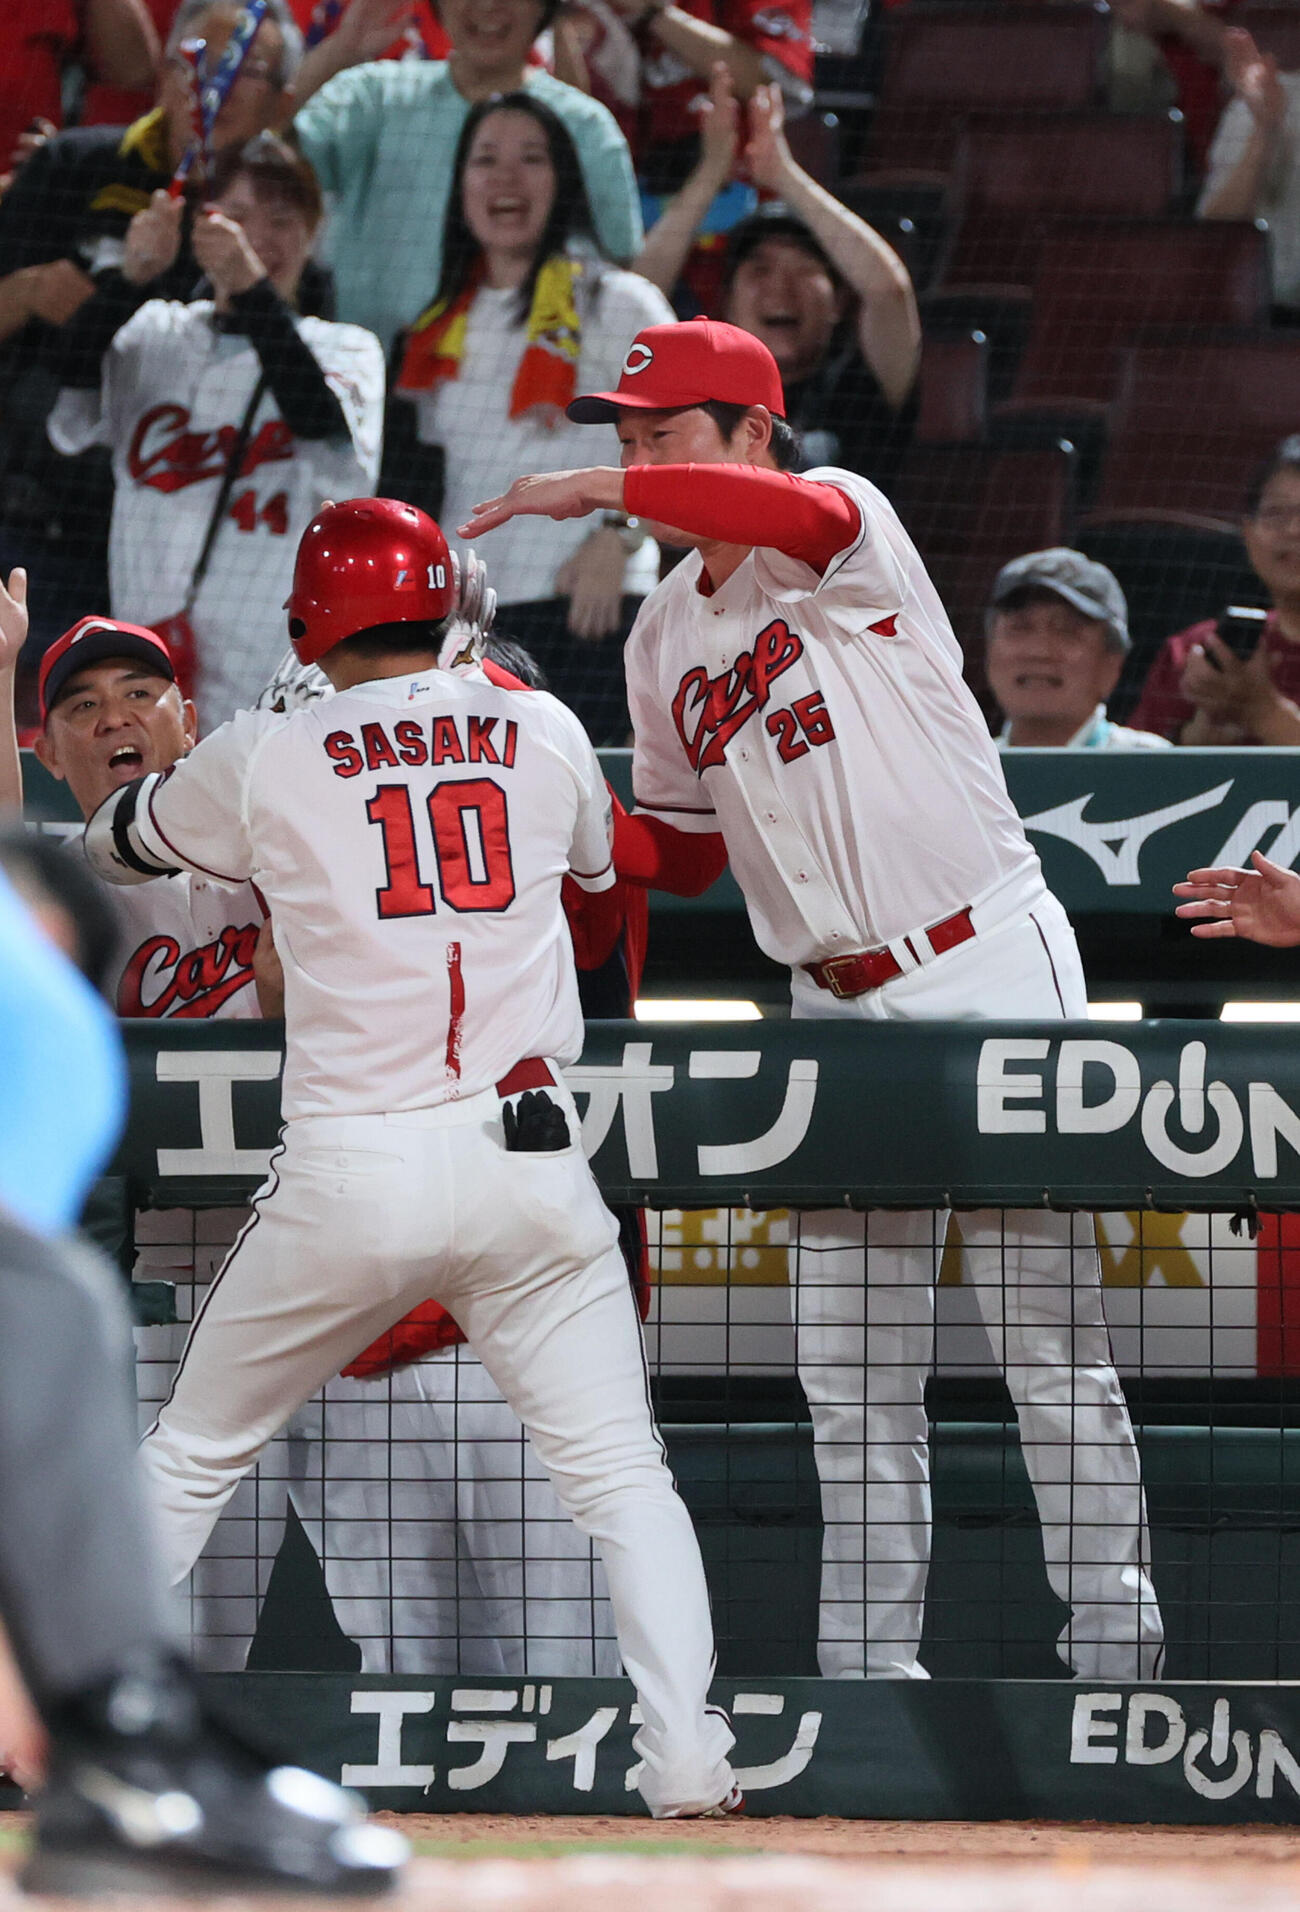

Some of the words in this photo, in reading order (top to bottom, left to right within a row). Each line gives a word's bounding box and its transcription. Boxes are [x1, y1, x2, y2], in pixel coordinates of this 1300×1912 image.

[128, 404, 295, 493] Carp
[230, 490, 288, 535] 44
[427, 564, 446, 589] 10
[323, 715, 518, 779] SASAKI
[766, 690, 836, 765] 25
[365, 777, 516, 920] 10
[117, 923, 262, 1018] Car
[341, 1684, 822, 1795] エディン
